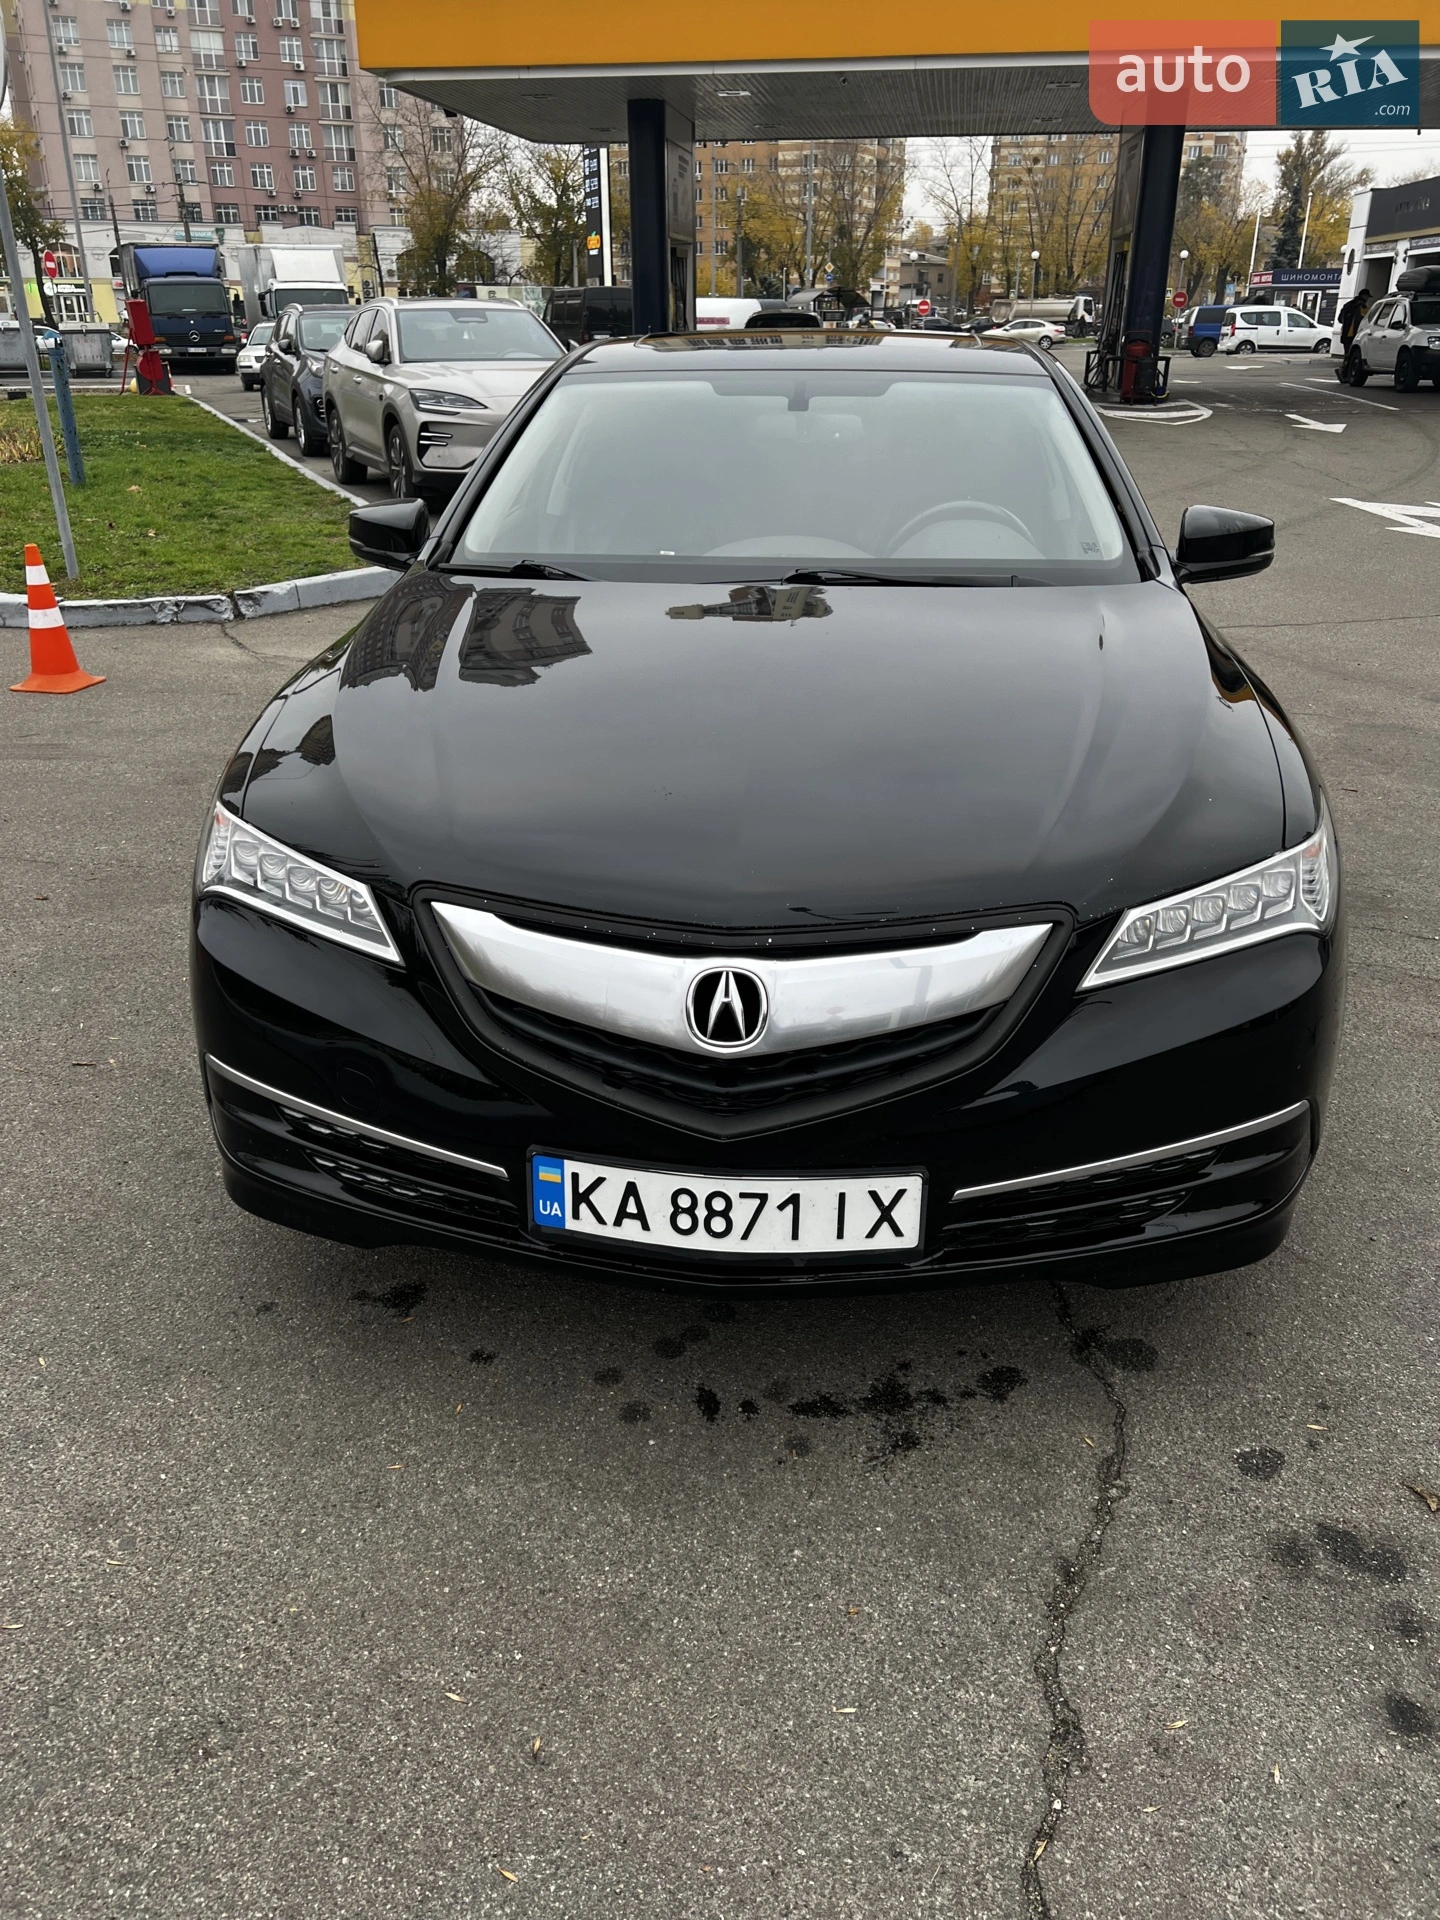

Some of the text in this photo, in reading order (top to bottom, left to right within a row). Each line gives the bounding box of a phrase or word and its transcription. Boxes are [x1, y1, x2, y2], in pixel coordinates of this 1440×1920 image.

[539, 1199, 562, 1218] UA
[570, 1172, 651, 1231] KA
[669, 1187, 801, 1240] 8871
